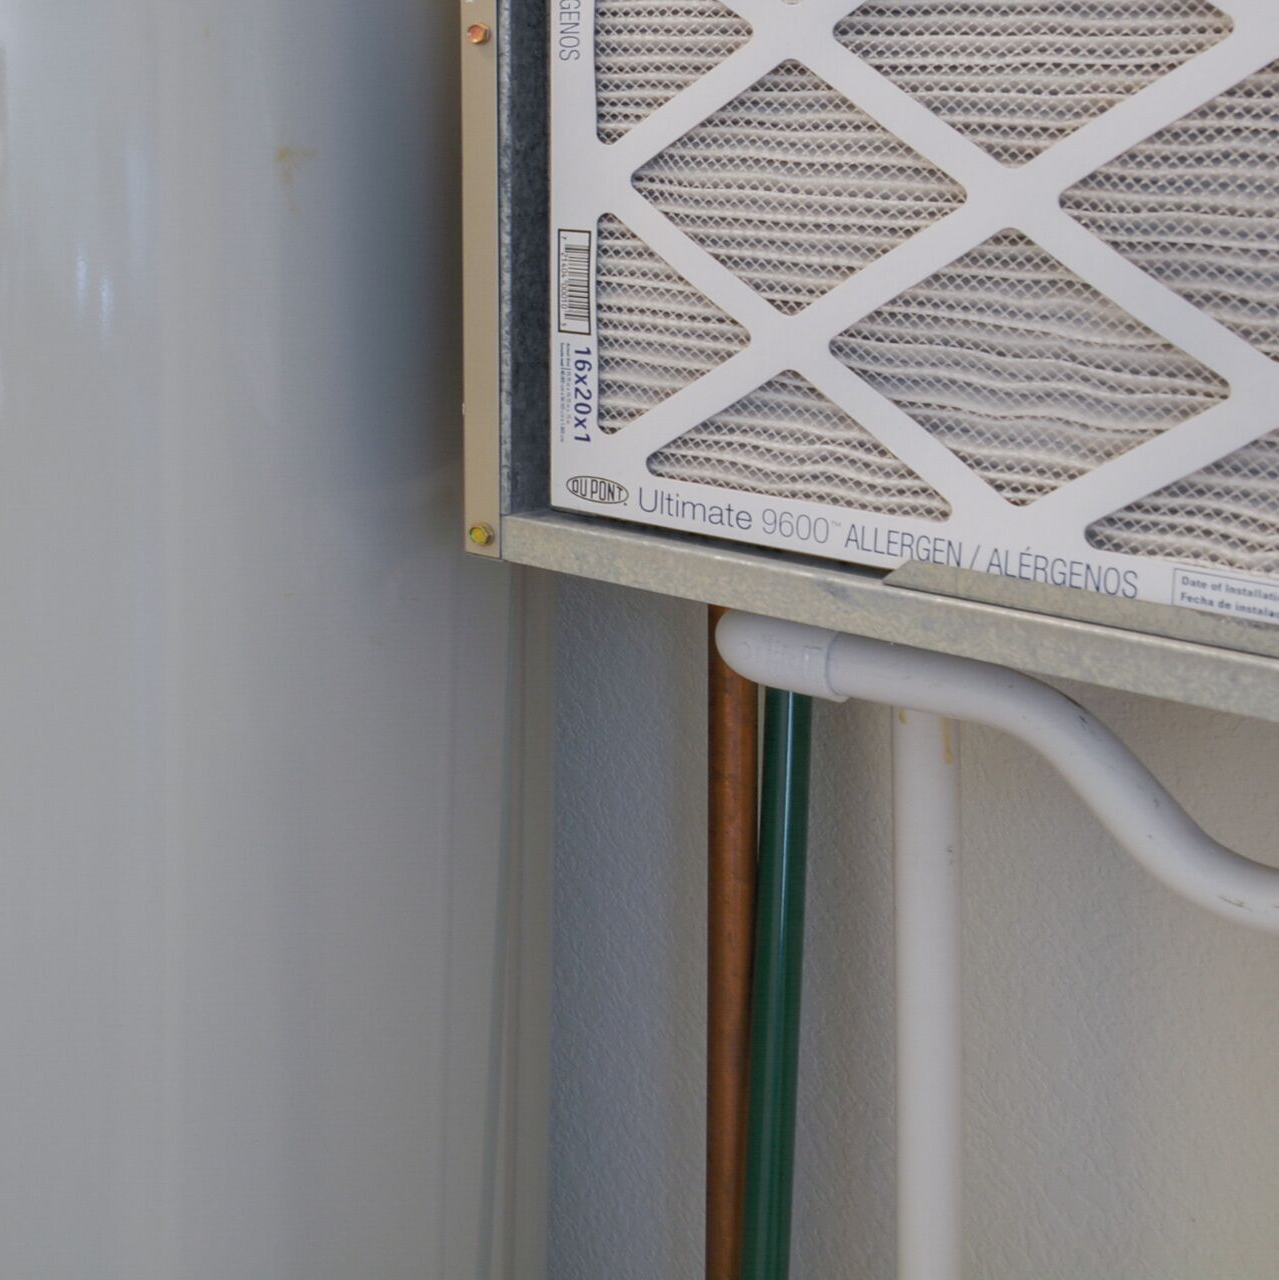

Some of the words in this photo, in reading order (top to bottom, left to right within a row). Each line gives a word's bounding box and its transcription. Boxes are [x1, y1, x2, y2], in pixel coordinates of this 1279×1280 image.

[574, 347, 591, 443] 16x20x1
[638, 487, 753, 530] Ultimate
[844, 524, 962, 568] ALLERGEN
[969, 545, 981, 569] /
[986, 546, 1139, 600] ALÉRGENOS
[1180, 591, 1214, 607] Fecha
[1218, 600, 1231, 610] de
[1181, 575, 1207, 590] Date
[1210, 582, 1222, 592] of
